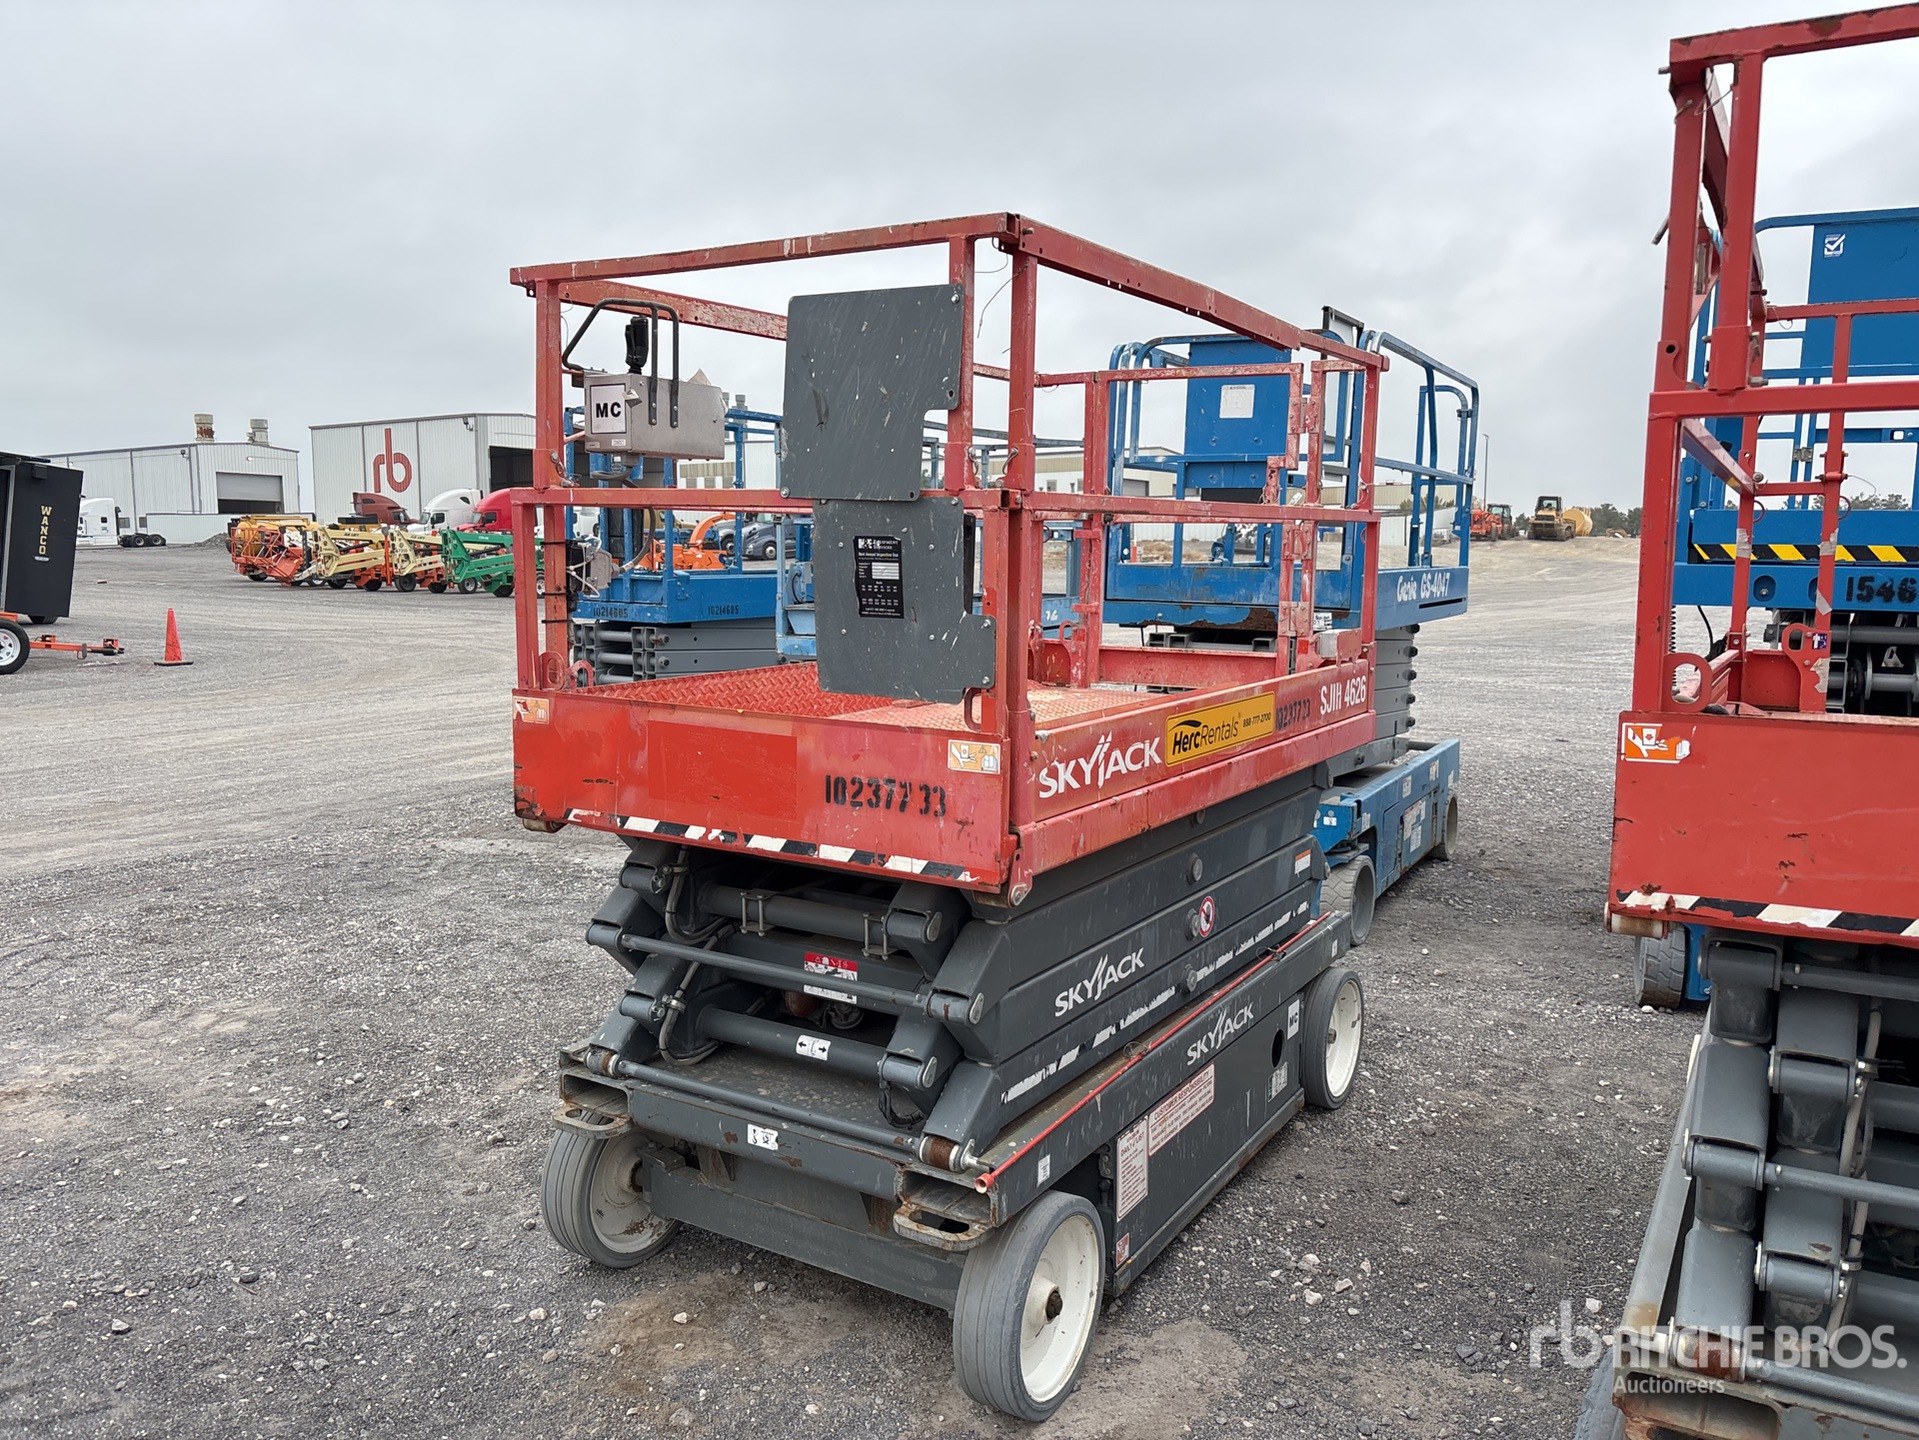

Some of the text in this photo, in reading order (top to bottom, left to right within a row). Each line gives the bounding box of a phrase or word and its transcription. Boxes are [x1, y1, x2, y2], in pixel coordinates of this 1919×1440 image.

[596, 401, 621, 418] MC
[373, 428, 413, 493] rb
[38, 505, 53, 555] WANCO
[1420, 572, 1451, 599] GS-4047
[1846, 576, 1918, 604] 1546
[593, 608, 629, 619] 10214605
[708, 605, 740, 616] 10214605
[1344, 675, 1367, 707] 4626
[1039, 731, 1162, 799] SKYJACK
[1055, 947, 1145, 1017] SKYJACK
[1187, 1001, 1254, 1066] SKYJACK
[1154, 1095, 1178, 1121] CUSTOMER
[1178, 1071, 1210, 1100] RESPONSIBILITY
